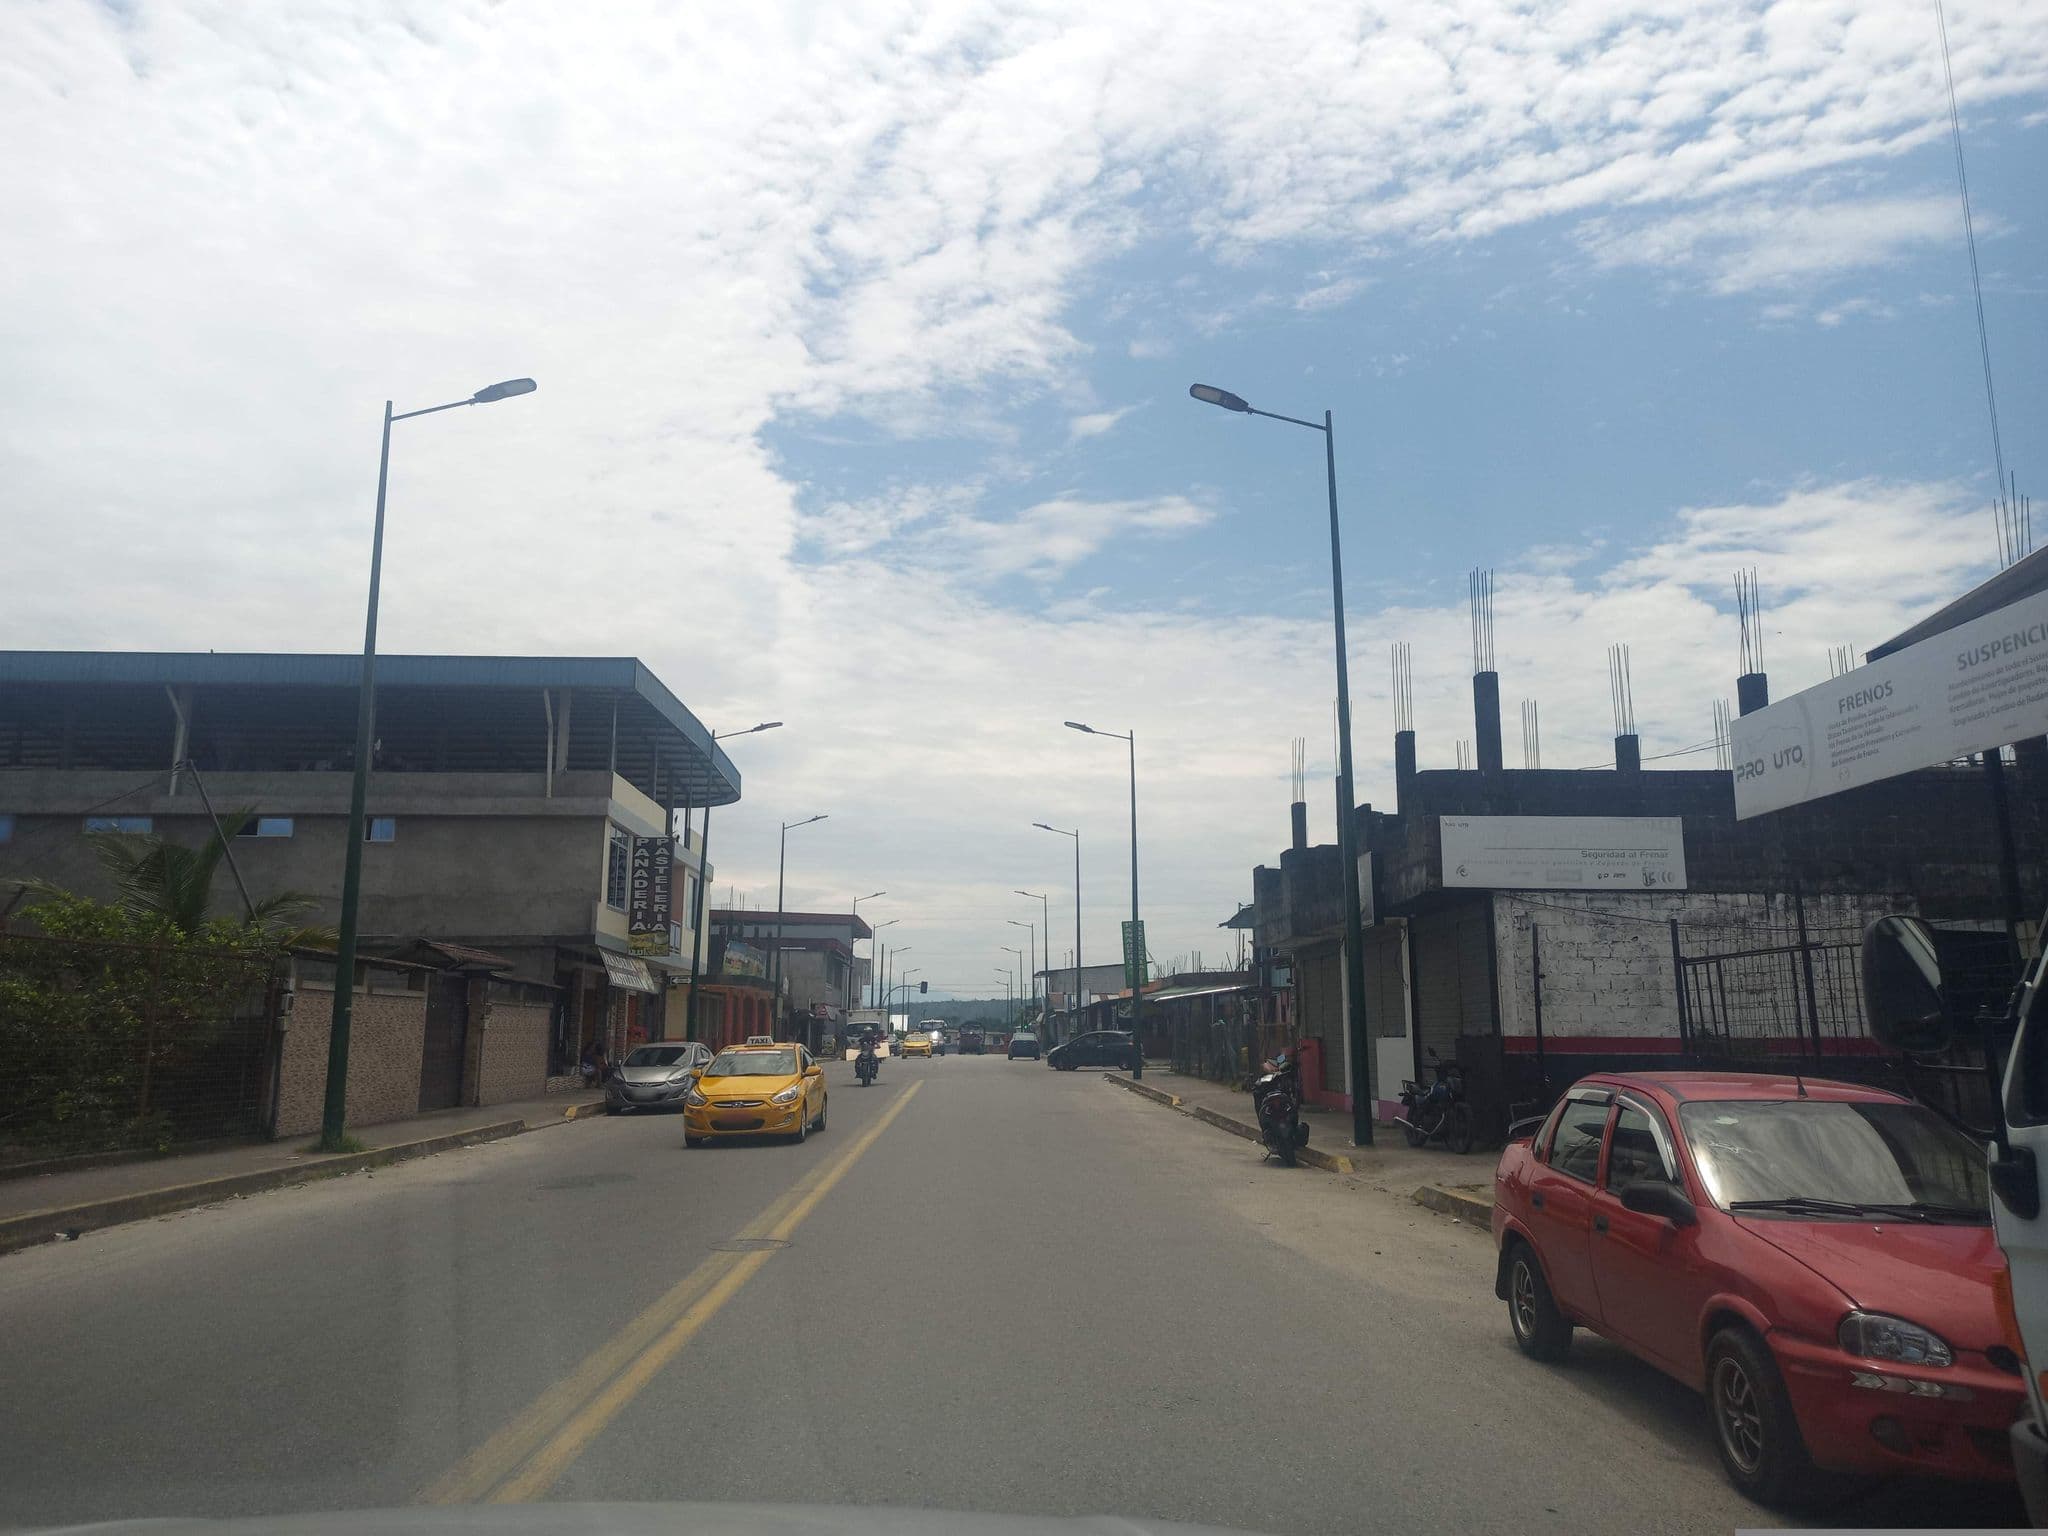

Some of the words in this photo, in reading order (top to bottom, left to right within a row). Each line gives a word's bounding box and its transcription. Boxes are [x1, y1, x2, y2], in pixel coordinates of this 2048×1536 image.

[1838, 680, 1893, 714] FRENOS
[1736, 758, 1765, 783] PRO
[1773, 745, 1803, 770] UTO
[1581, 850, 1625, 859] Seguridad
[631, 838, 649, 931] PANADERIA
[651, 838, 670, 932] PASTELERIA
